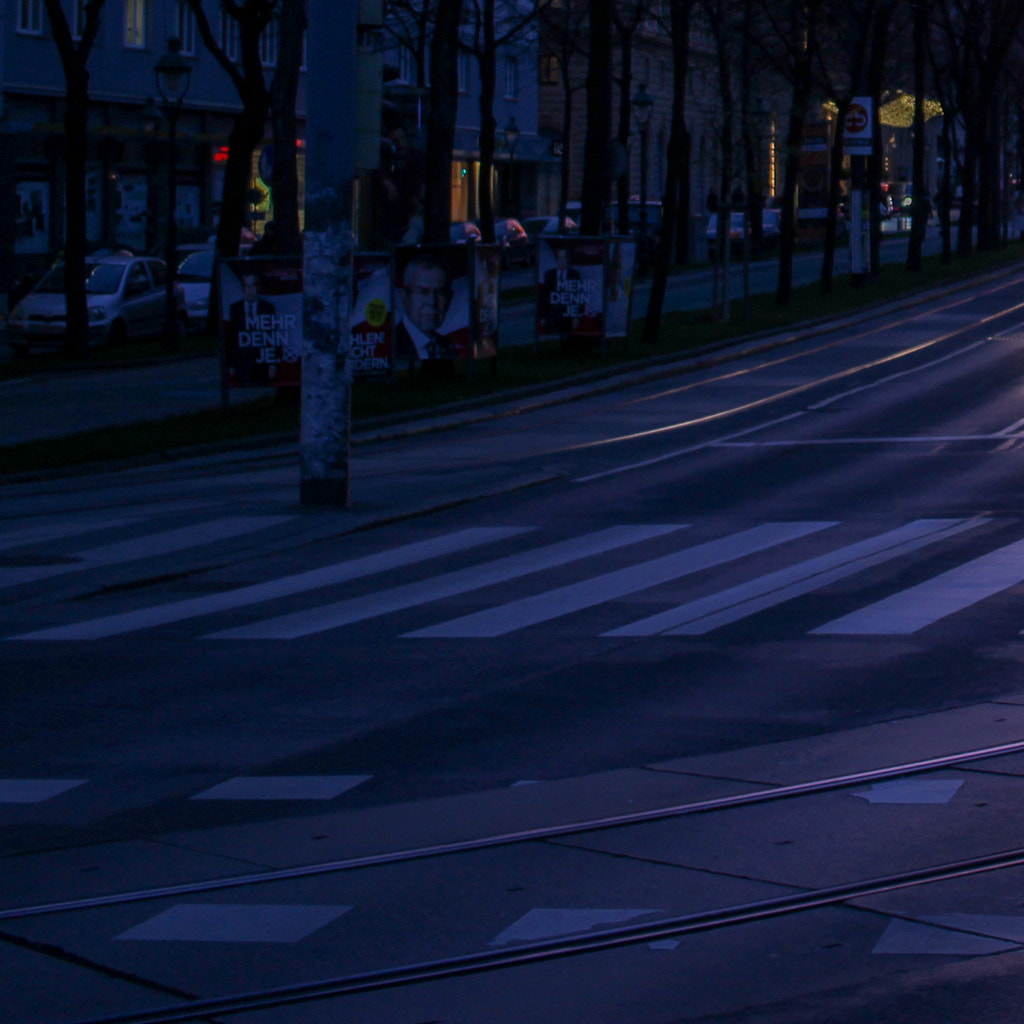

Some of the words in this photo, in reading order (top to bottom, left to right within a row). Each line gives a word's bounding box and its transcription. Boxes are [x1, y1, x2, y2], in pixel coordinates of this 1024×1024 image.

[557, 279, 597, 292] MEHR
[549, 292, 590, 304] DENN
[245, 314, 297, 330] MEHR
[238, 331, 289, 347] DENN
